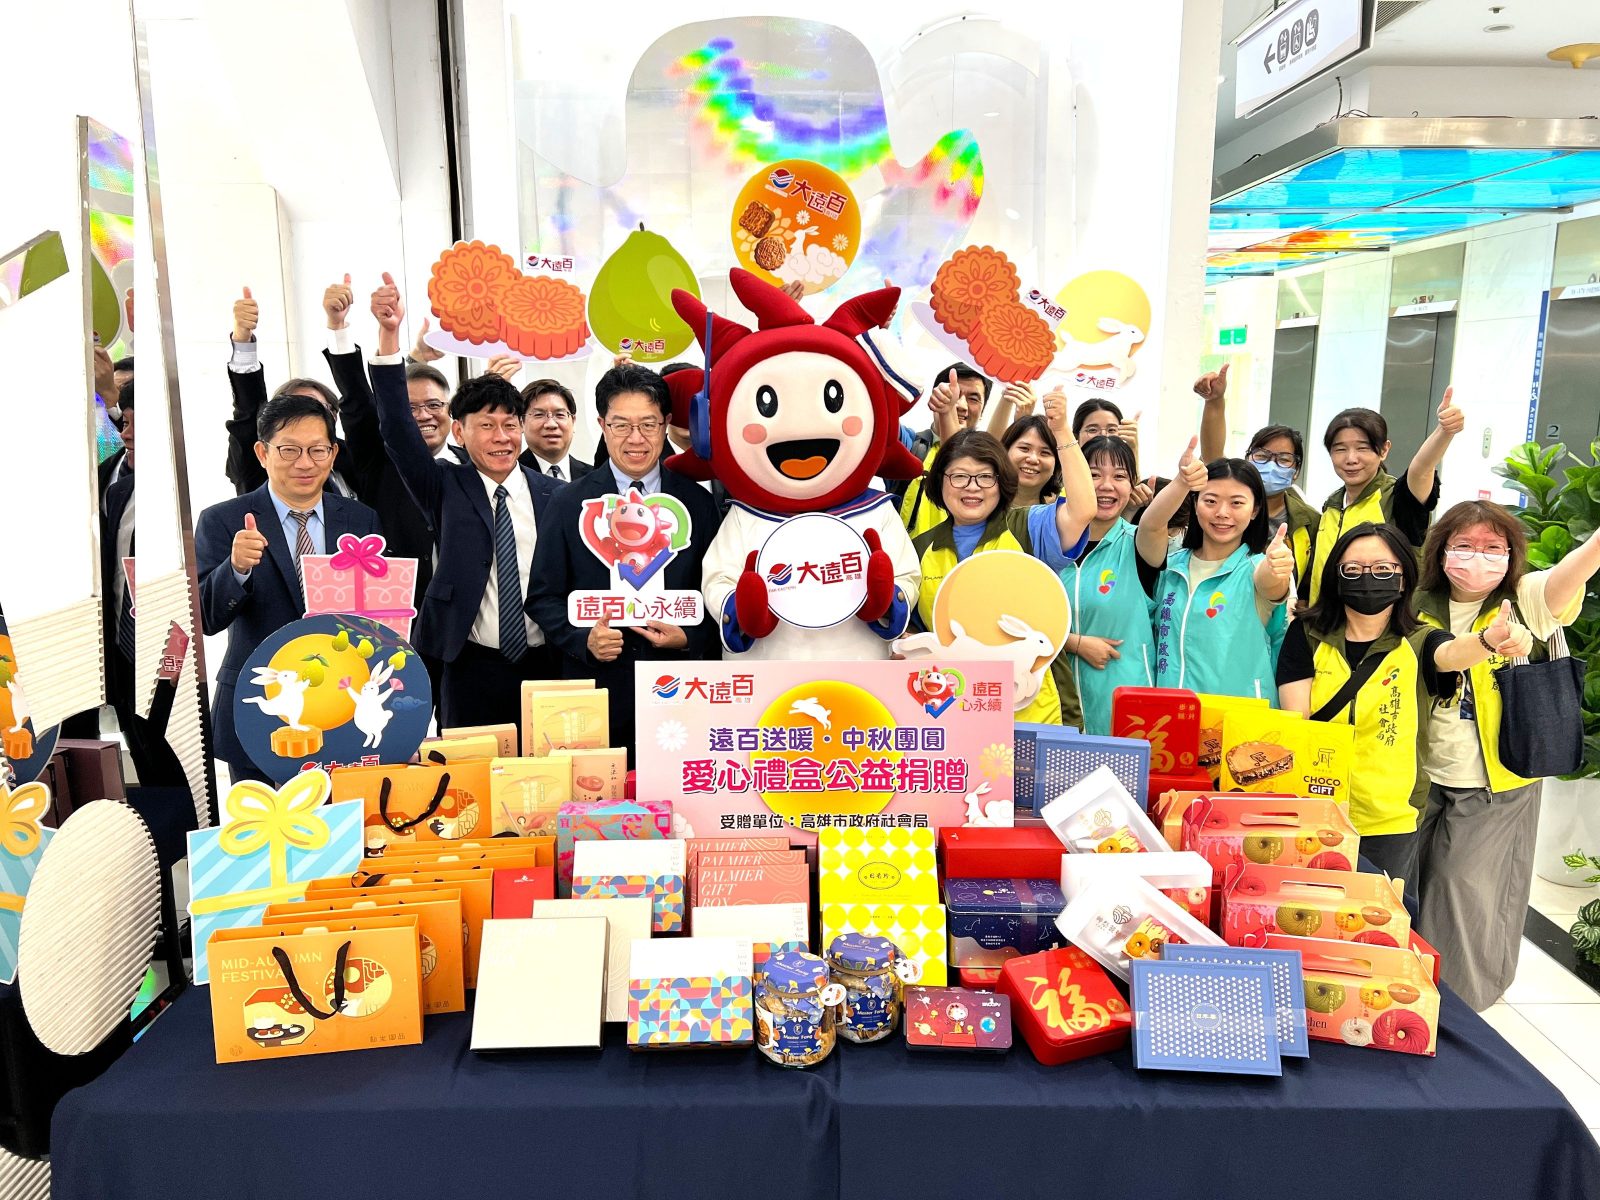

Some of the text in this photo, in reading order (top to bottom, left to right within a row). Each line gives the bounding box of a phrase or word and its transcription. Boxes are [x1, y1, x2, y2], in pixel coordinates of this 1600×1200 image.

[790, 180, 848, 214] 大遠百
[541, 257, 573, 272] 大遠百
[634, 339, 665, 353] 大遠百
[1548, 425, 1559, 438] 2
[797, 551, 863, 585] 大遠百
[684, 674, 755, 704] 大遠百
[972, 682, 1002, 697] 遠百
[962, 698, 1002, 712] 心永續
[1376, 703, 1390, 741] 社會局
[1384, 685, 1401, 747] 高雄市政府
[682, 757, 968, 794] 愛心禮盒公益捐贈
[1303, 775, 1341, 787] CHOCO
[1310, 785, 1333, 796] GIFT
[701, 869, 764, 883] PALMIER
[701, 884, 737, 896] GIFT
